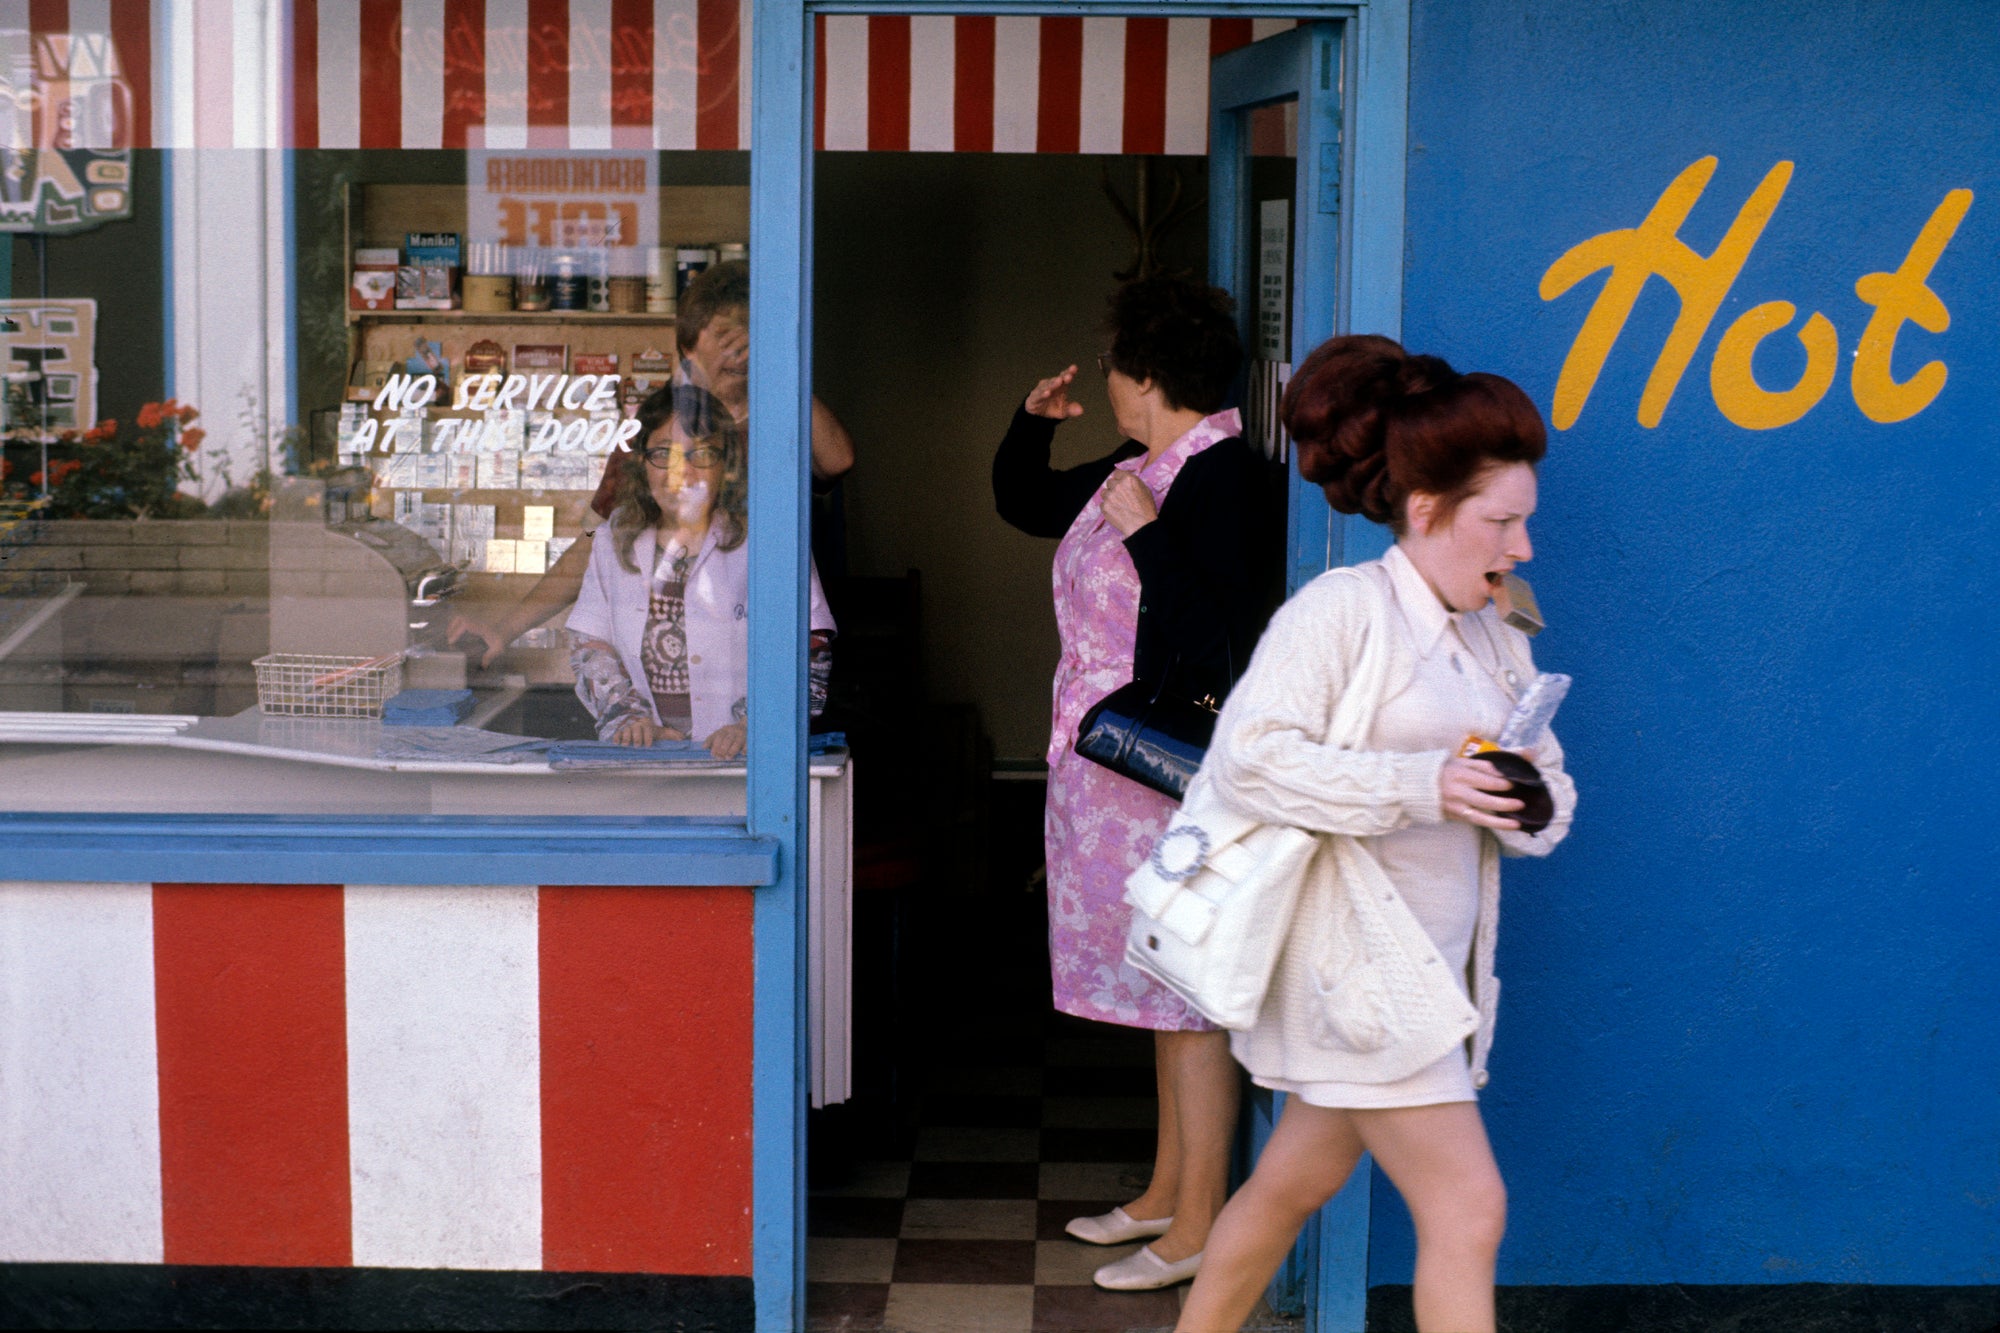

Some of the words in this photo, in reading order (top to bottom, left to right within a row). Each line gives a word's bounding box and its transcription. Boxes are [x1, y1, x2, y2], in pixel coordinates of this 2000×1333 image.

[410, 233, 456, 248] Manikin
[1539, 155, 1974, 431] Hot
[373, 374, 436, 411] NO
[452, 374, 621, 411] SERVICE
[350, 418, 408, 452] AT
[432, 418, 515, 452] THIS
[528, 418, 642, 452] DOOR
